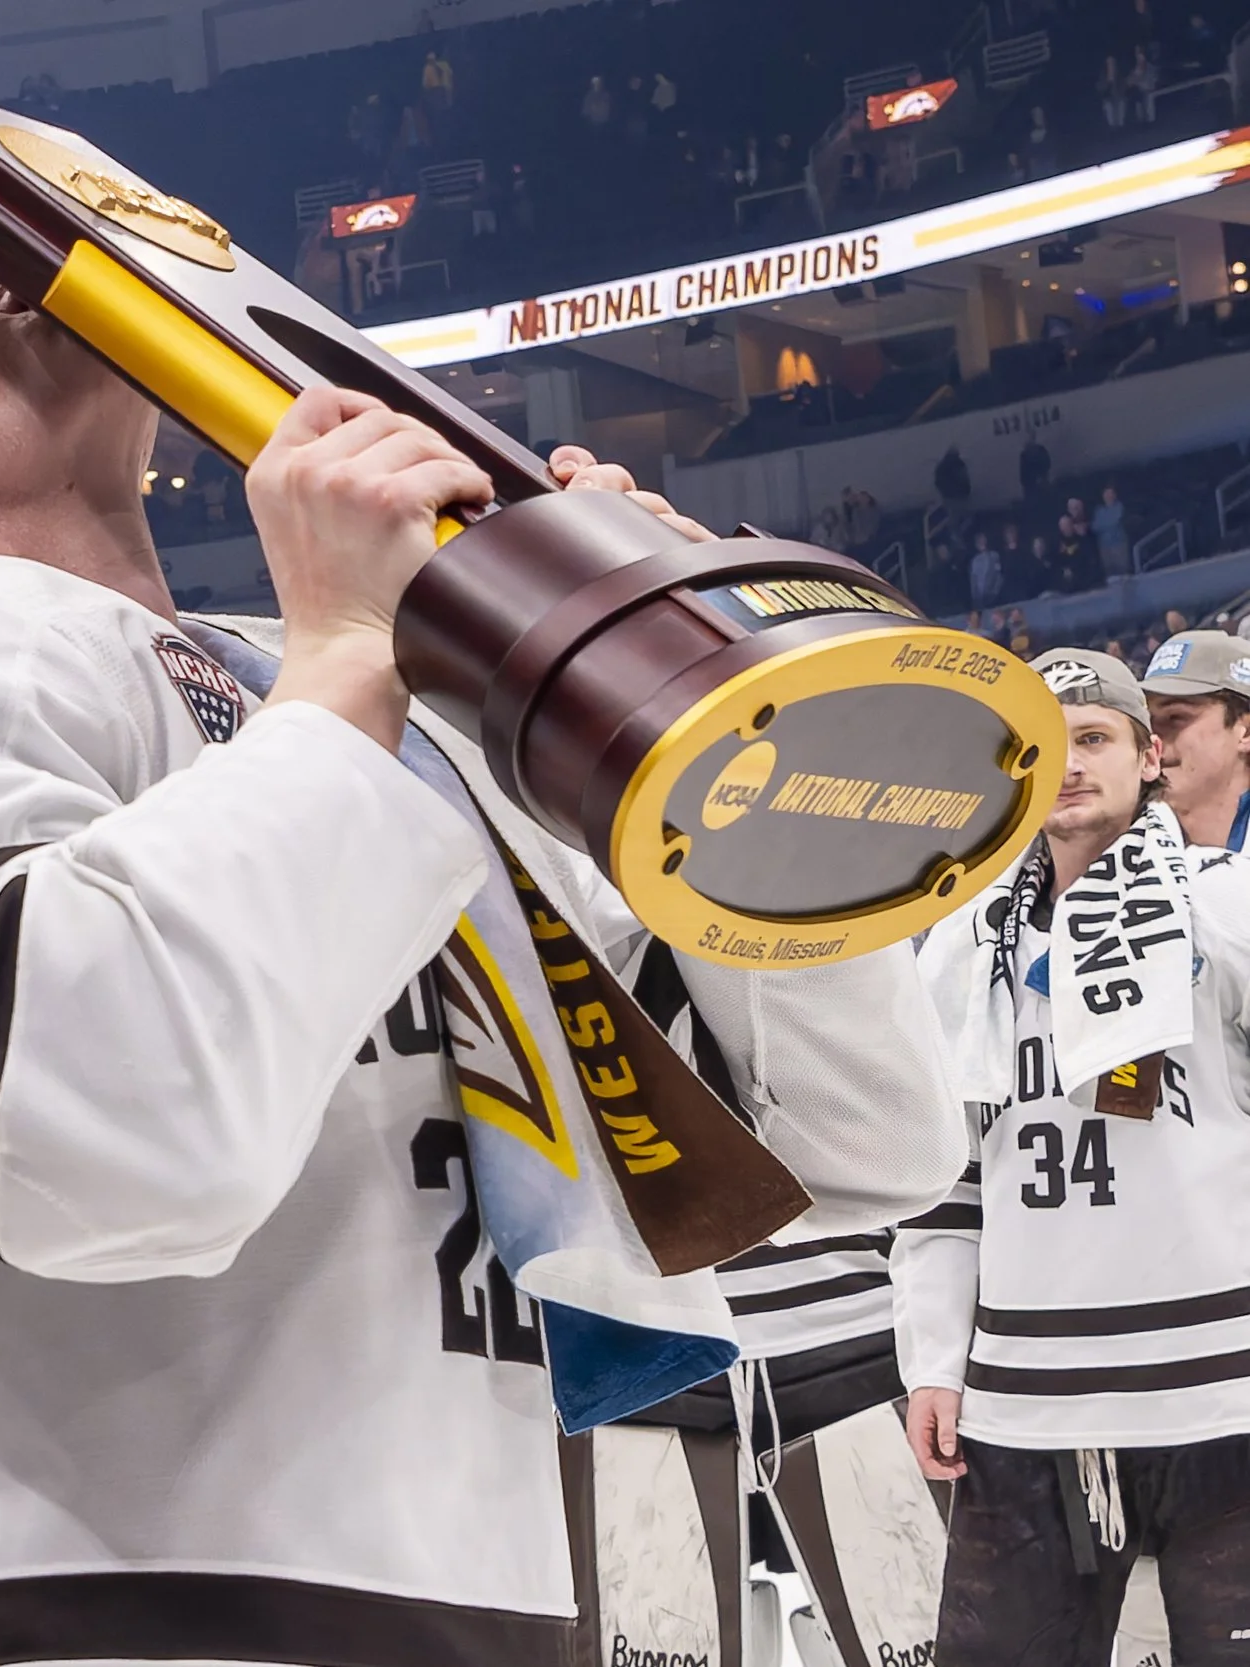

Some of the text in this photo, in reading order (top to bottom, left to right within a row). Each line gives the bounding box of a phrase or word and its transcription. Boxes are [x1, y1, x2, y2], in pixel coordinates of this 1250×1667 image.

[509, 235, 879, 345] NATIONAL CHAMPIONS
[158, 648, 241, 704] NCHC
[892, 643, 1008, 686] April 12, 2025
[768, 771, 985, 830] NATIONAL CHAMPION
[721, 931, 768, 963] Louis,
[767, 932, 850, 961] Missouri
[1017, 1118, 1116, 1209] 34
